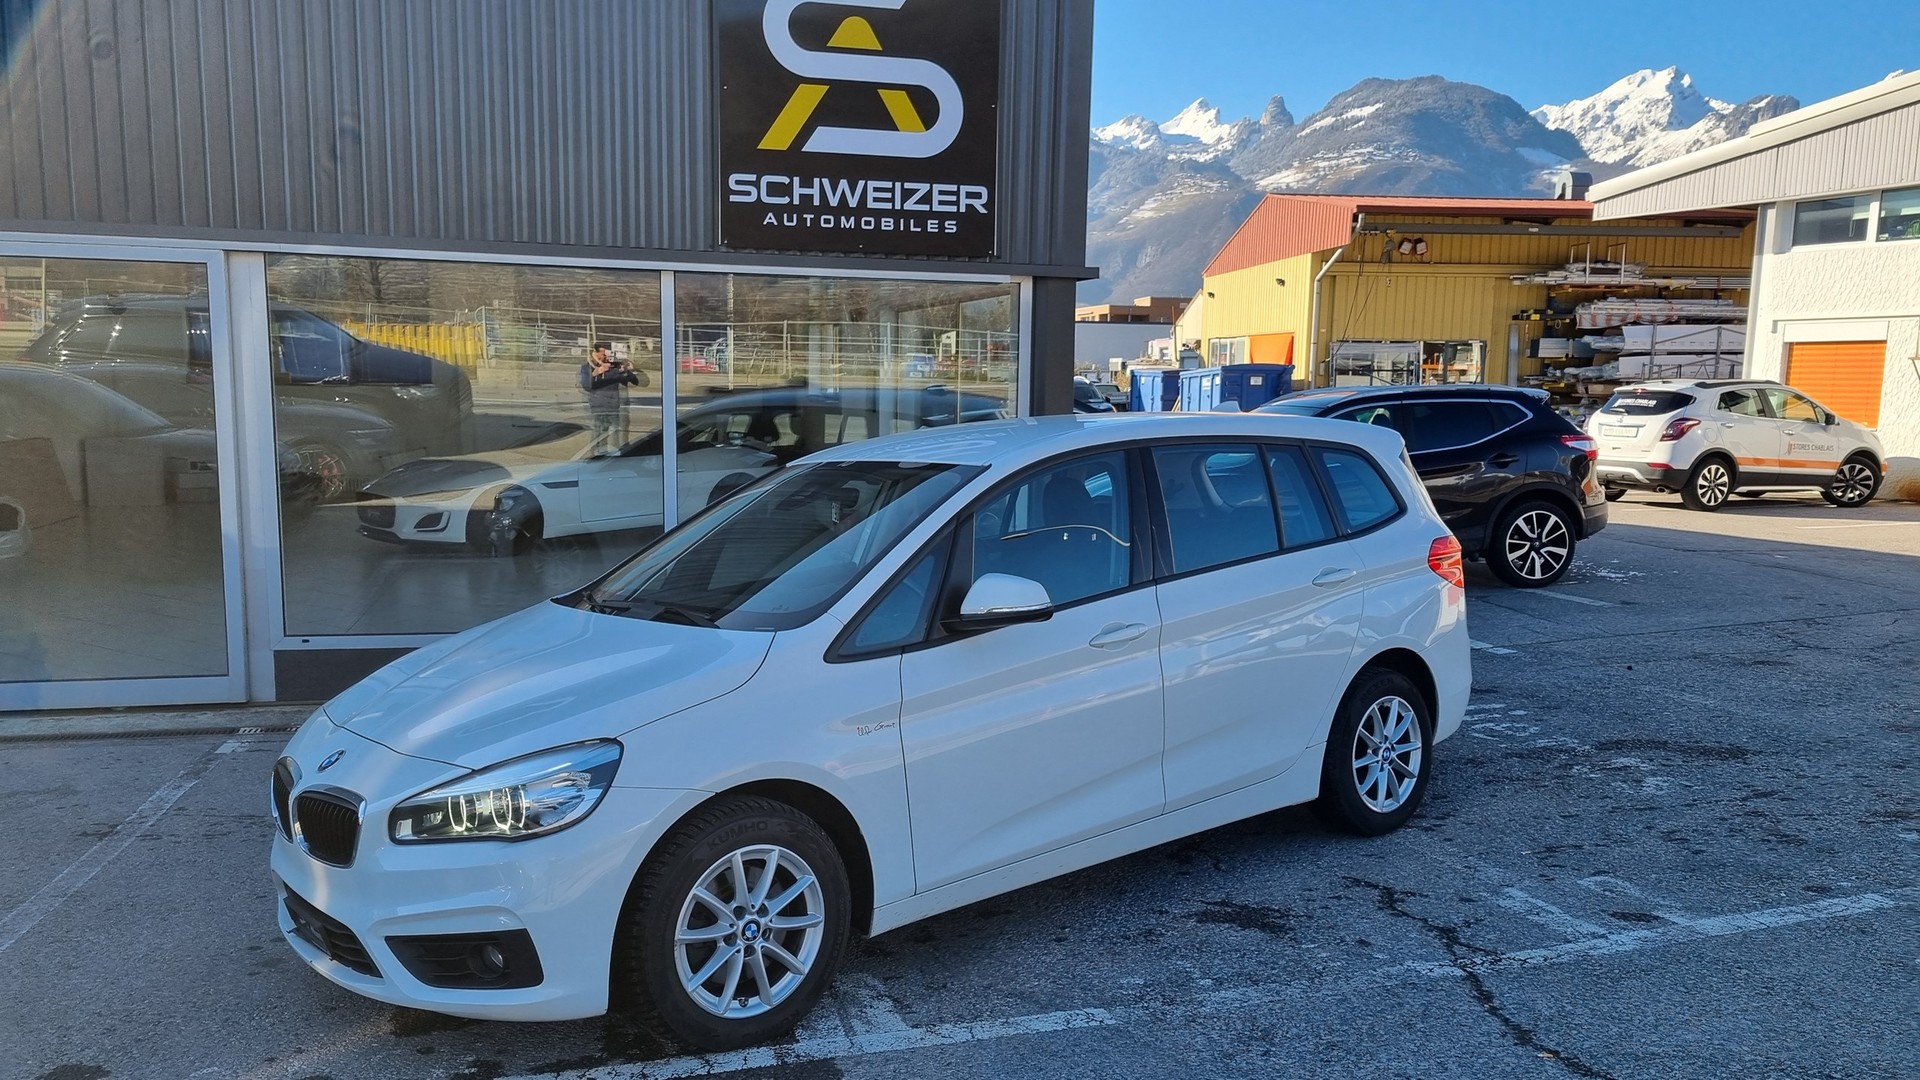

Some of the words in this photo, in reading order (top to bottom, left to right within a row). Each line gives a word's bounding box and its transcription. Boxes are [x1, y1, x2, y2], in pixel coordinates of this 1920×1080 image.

[728, 173, 988, 214] SCHWEIZER
[763, 212, 957, 233] AUTOMOBILES
[1792, 443, 1810, 451] STORES
[1811, 444, 1834, 452] CHABLAIS
[706, 820, 768, 850] KUMHO
